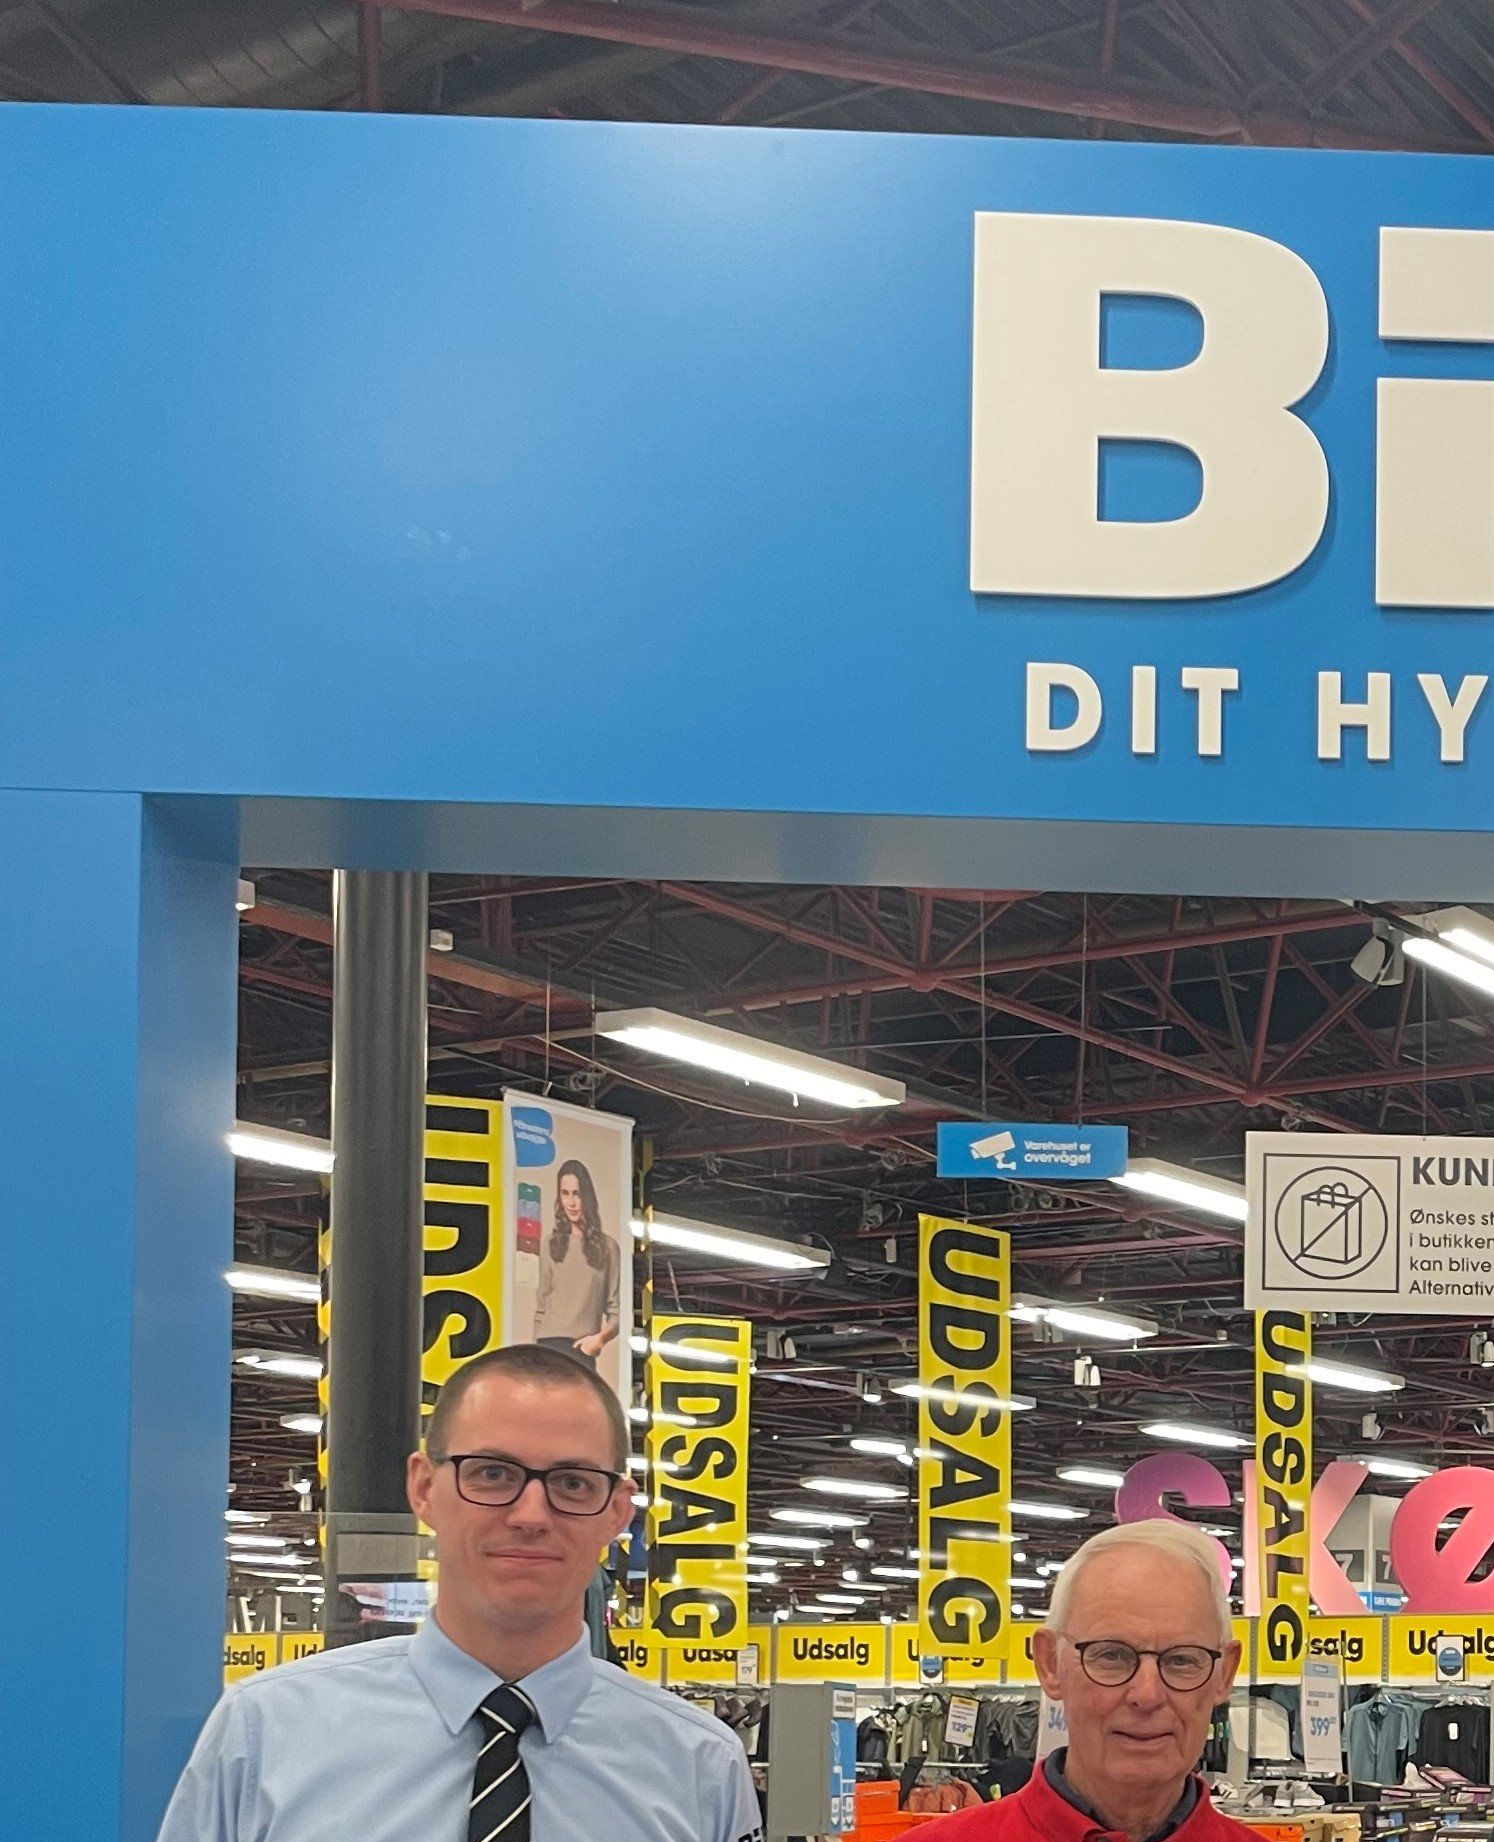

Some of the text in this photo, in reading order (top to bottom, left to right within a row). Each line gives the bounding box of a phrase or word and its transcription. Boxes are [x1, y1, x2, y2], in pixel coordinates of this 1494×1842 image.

[1025, 660, 1240, 760] DIT
[1024, 1151, 1091, 1167] overvåget
[1409, 1208, 1476, 1226] Ønskes
[1408, 1232, 1414, 1247] i
[1409, 1256, 1443, 1271] kan
[1449, 1257, 1492, 1273] blive
[928, 1229, 1001, 1645] UDSALG
[657, 1321, 740, 1641] UDSALG
[1261, 1311, 1304, 1662] UDSALG
[224, 1644, 265, 1670] dsalg
[793, 1636, 870, 1666] Udsalg
[1311, 1630, 1363, 1662] salg
